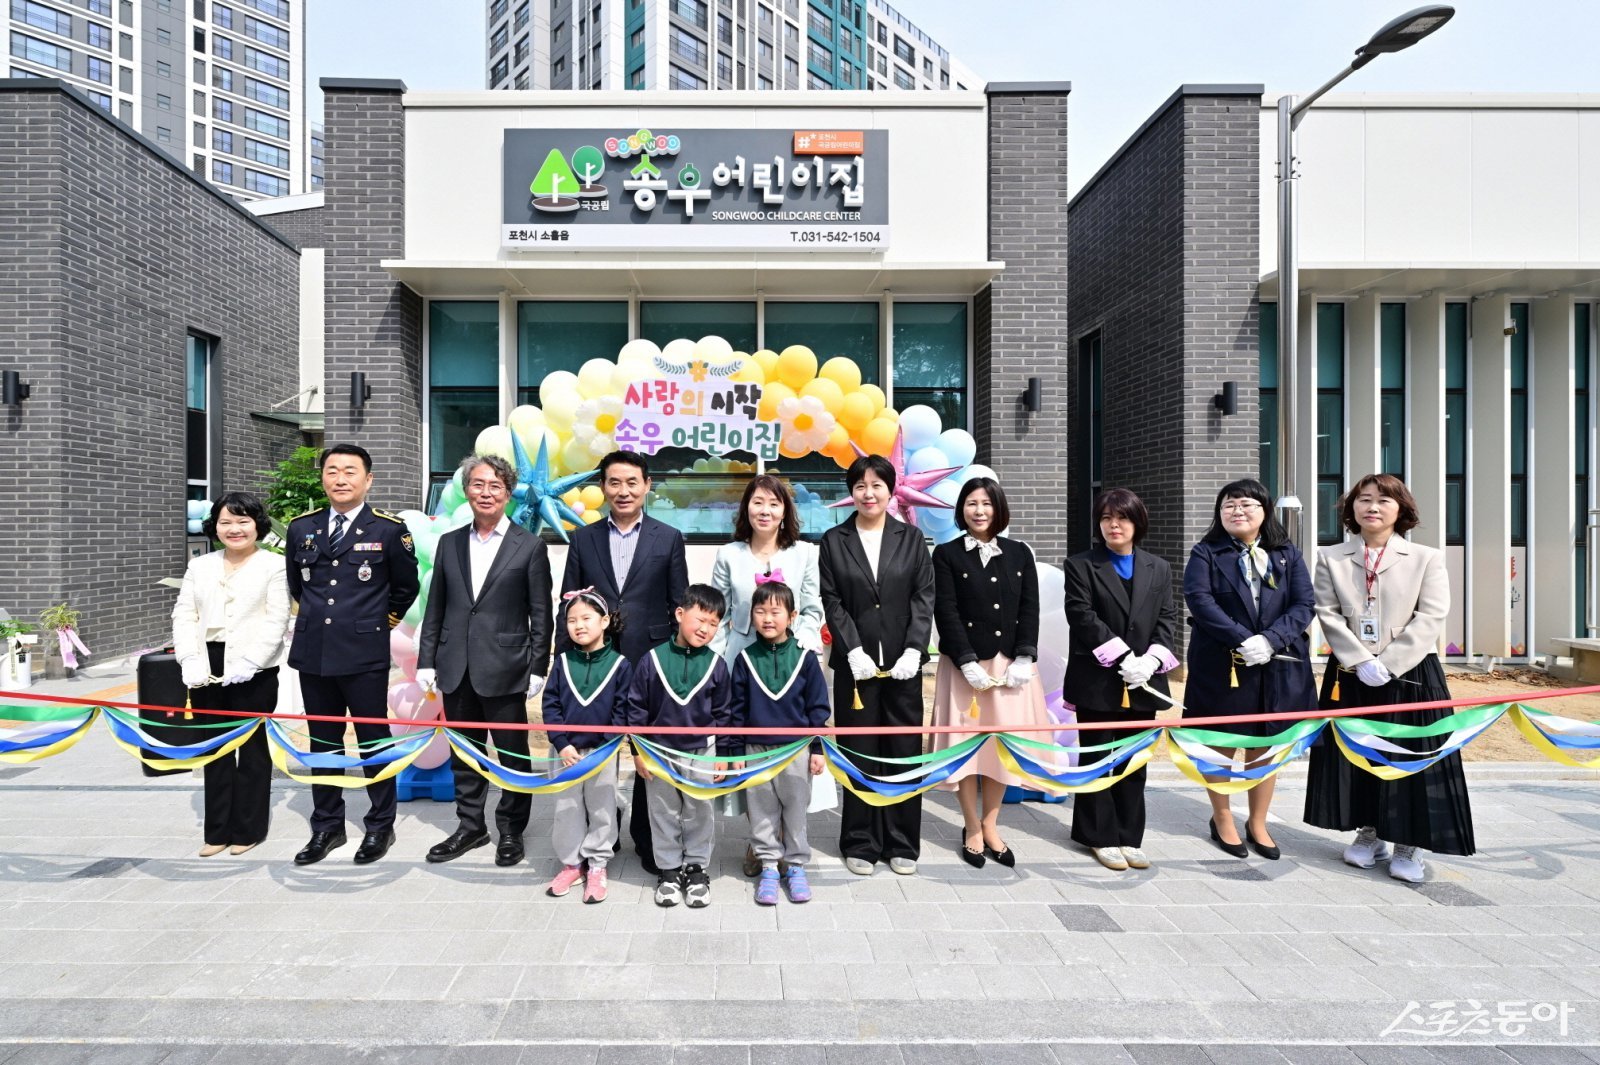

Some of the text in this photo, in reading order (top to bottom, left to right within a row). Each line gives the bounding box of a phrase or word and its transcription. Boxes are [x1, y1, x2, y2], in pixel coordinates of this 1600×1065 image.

[606, 129, 679, 154] SONGWOO
[623, 153, 865, 217] 송우 어린이집
[580, 200, 610, 212] 국공립
[711, 211, 861, 221] SONGWOO CHILDCARE CENTER
[508, 229, 538, 241] 포천시
[790, 231, 881, 243] T.031-542-1504
[624, 380, 763, 421] 사랑의 시작
[615, 418, 781, 460] 송우 어린이집
